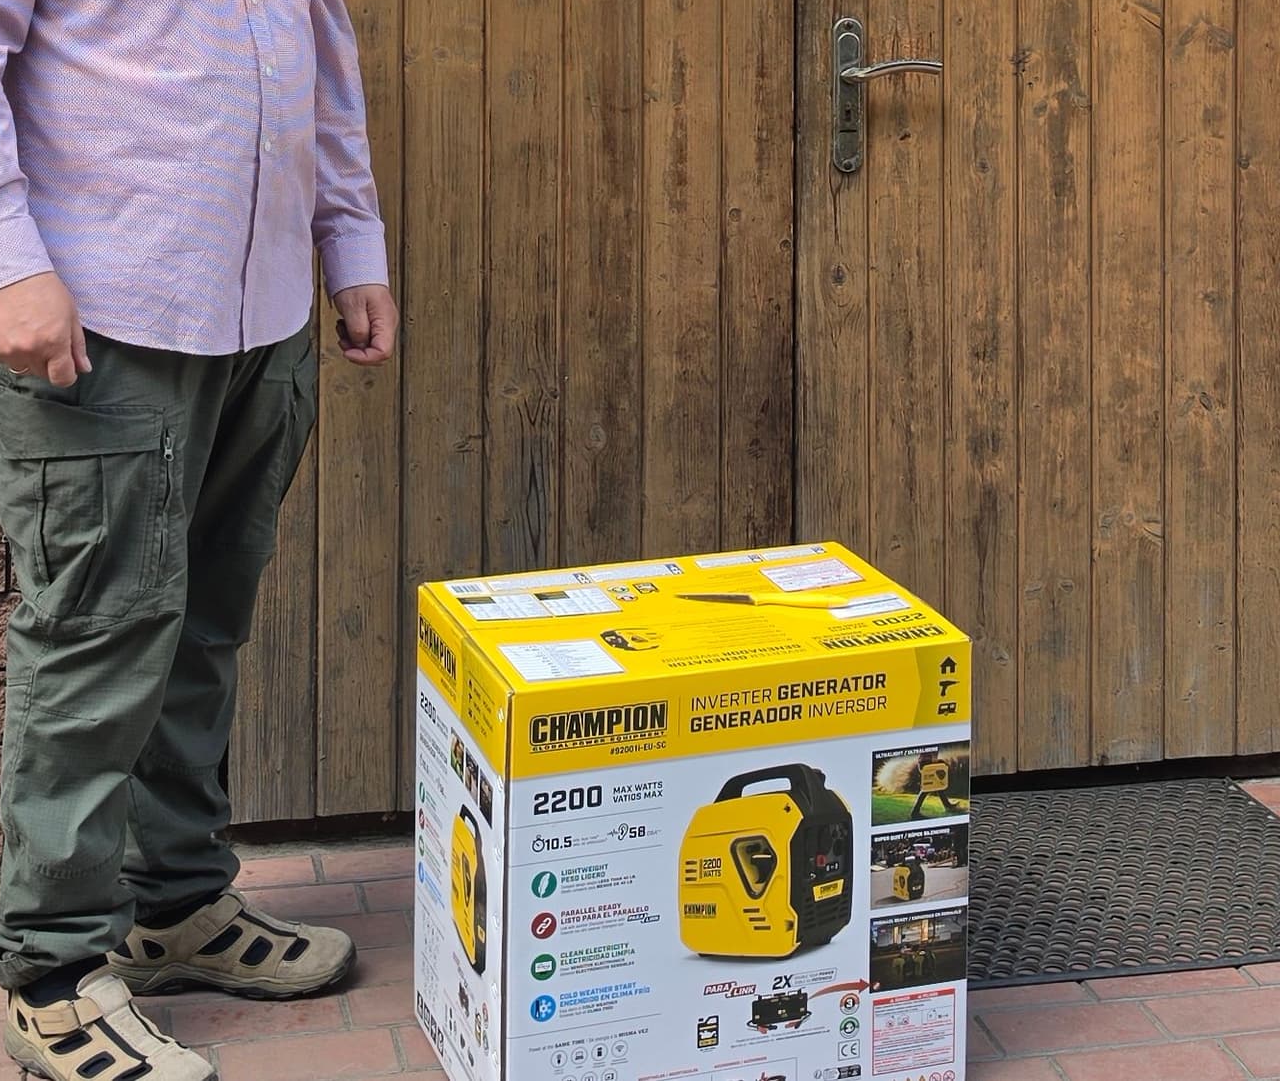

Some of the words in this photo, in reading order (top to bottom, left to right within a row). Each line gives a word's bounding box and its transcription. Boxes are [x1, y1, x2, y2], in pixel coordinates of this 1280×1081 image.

[821, 624, 946, 650] CHAMPION
[419, 617, 457, 681] CHAMPION
[691, 688, 772, 712] INVERTER
[777, 673, 887, 701] GENERATOR
[531, 702, 667, 745] CHAMPION
[690, 704, 803, 733] GENERADOR
[808, 696, 888, 719] INVERSOR
[533, 785, 603, 816] 2200
[613, 785, 633, 795] MAX
[634, 781, 663, 792] WATTS
[612, 792, 642, 804] VATIOS
[644, 790, 663, 799] MAX
[545, 836, 573, 851] 10.5
[629, 826, 646, 839] 58
[561, 863, 609, 876] LIGHTWEIGHT
[702, 857, 722, 869] 2200
[561, 874, 580, 884] PESO
[581, 871, 606, 881] LIGERO
[702, 869, 722, 878] WATTS
[561, 906, 596, 917] PARALLEL
[598, 902, 622, 913] READY
[561, 915, 581, 925] LISTO
[582, 913, 601, 923] PARA
[603, 911, 612, 919] EL
[613, 905, 649, 917] PARALELO
[684, 904, 717, 915] CHAMPION
[560, 950, 584, 959] CLEAN
[585, 943, 629, 955] ELECTRICITY
[561, 953, 610, 966] ELECTRICIDAD
[611, 948, 635, 958] LIMPIA
[560, 991, 578, 1000] COLD
[579, 985, 613, 998] WEATHER
[614, 982, 637, 992] START
[772, 974, 794, 990] 2X
[560, 996, 599, 1008] ENCENDIDO
[611, 990, 633, 1000] CLIMA
